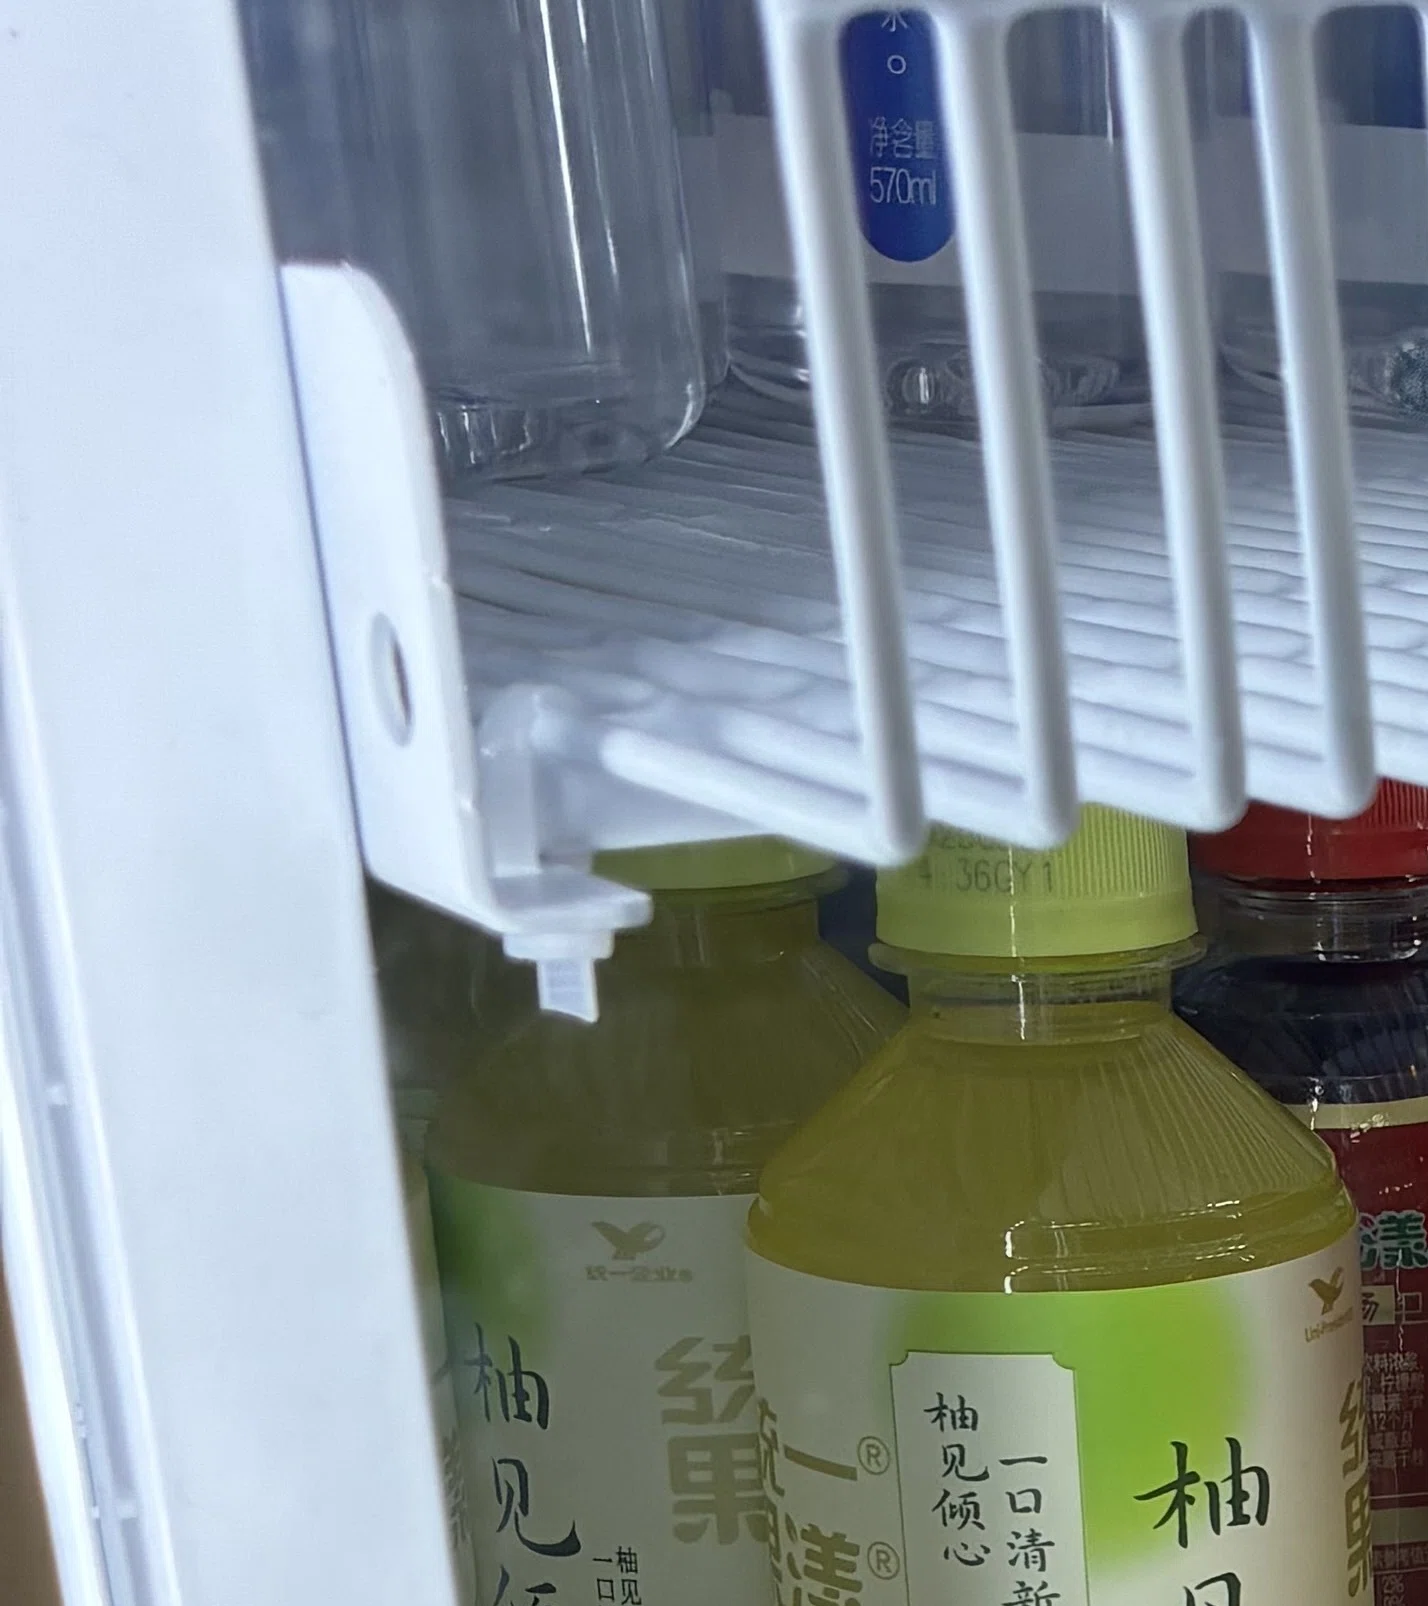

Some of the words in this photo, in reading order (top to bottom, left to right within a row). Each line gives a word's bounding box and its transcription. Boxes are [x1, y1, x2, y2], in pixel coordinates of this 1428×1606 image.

[870, 116, 937, 159] 净含量
[870, 166, 937, 205] 570ml
[923, 1391, 992, 1567] 柚见倾心
